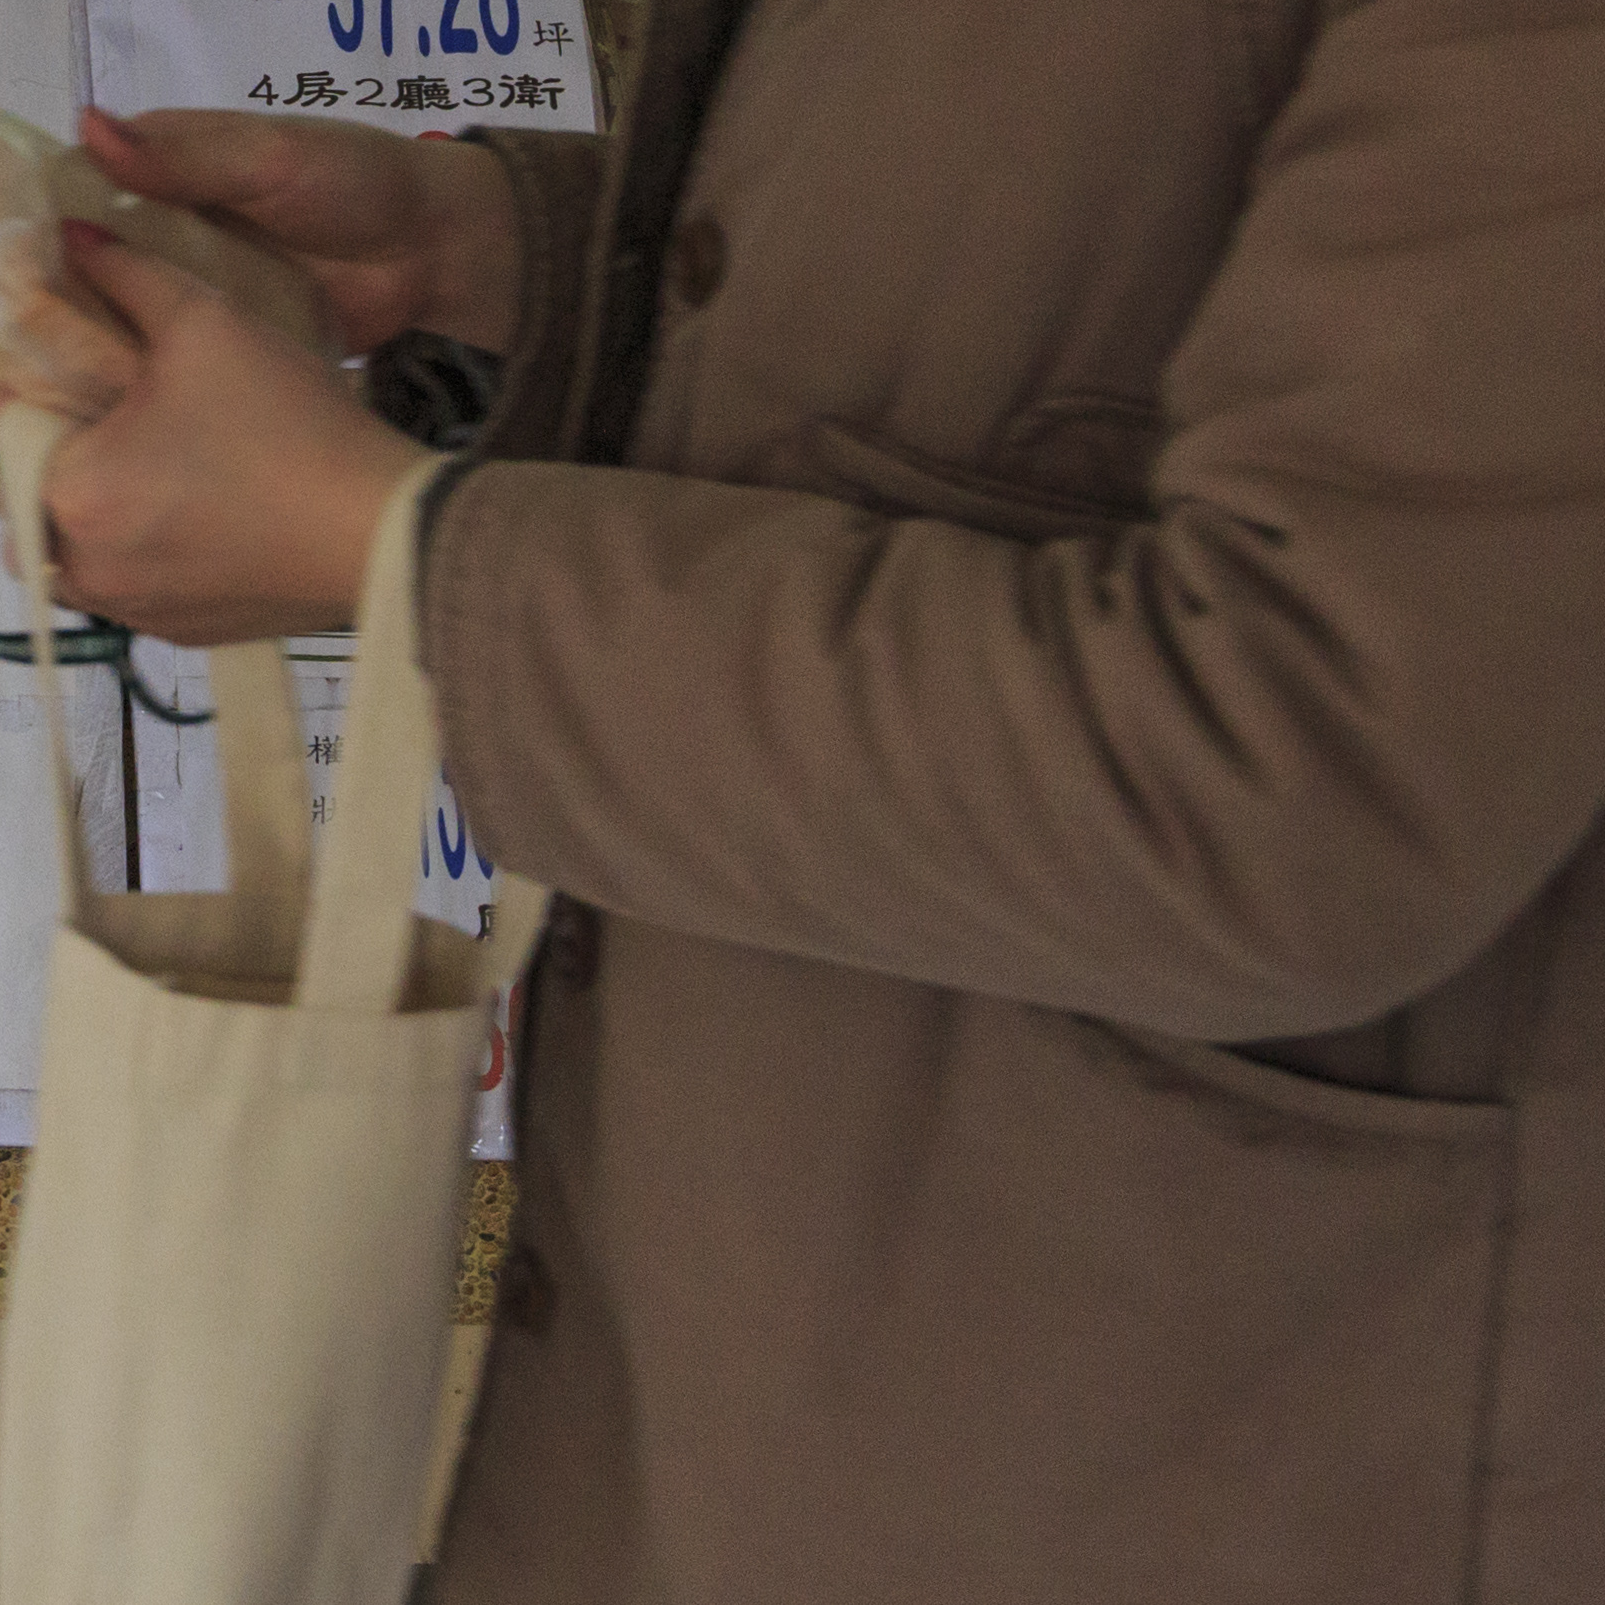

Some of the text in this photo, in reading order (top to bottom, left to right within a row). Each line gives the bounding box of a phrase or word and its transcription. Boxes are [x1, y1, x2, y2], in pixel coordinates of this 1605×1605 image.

[533, 20, 574, 56] 坪
[247, 71, 565, 110] 4房2廳3衛
